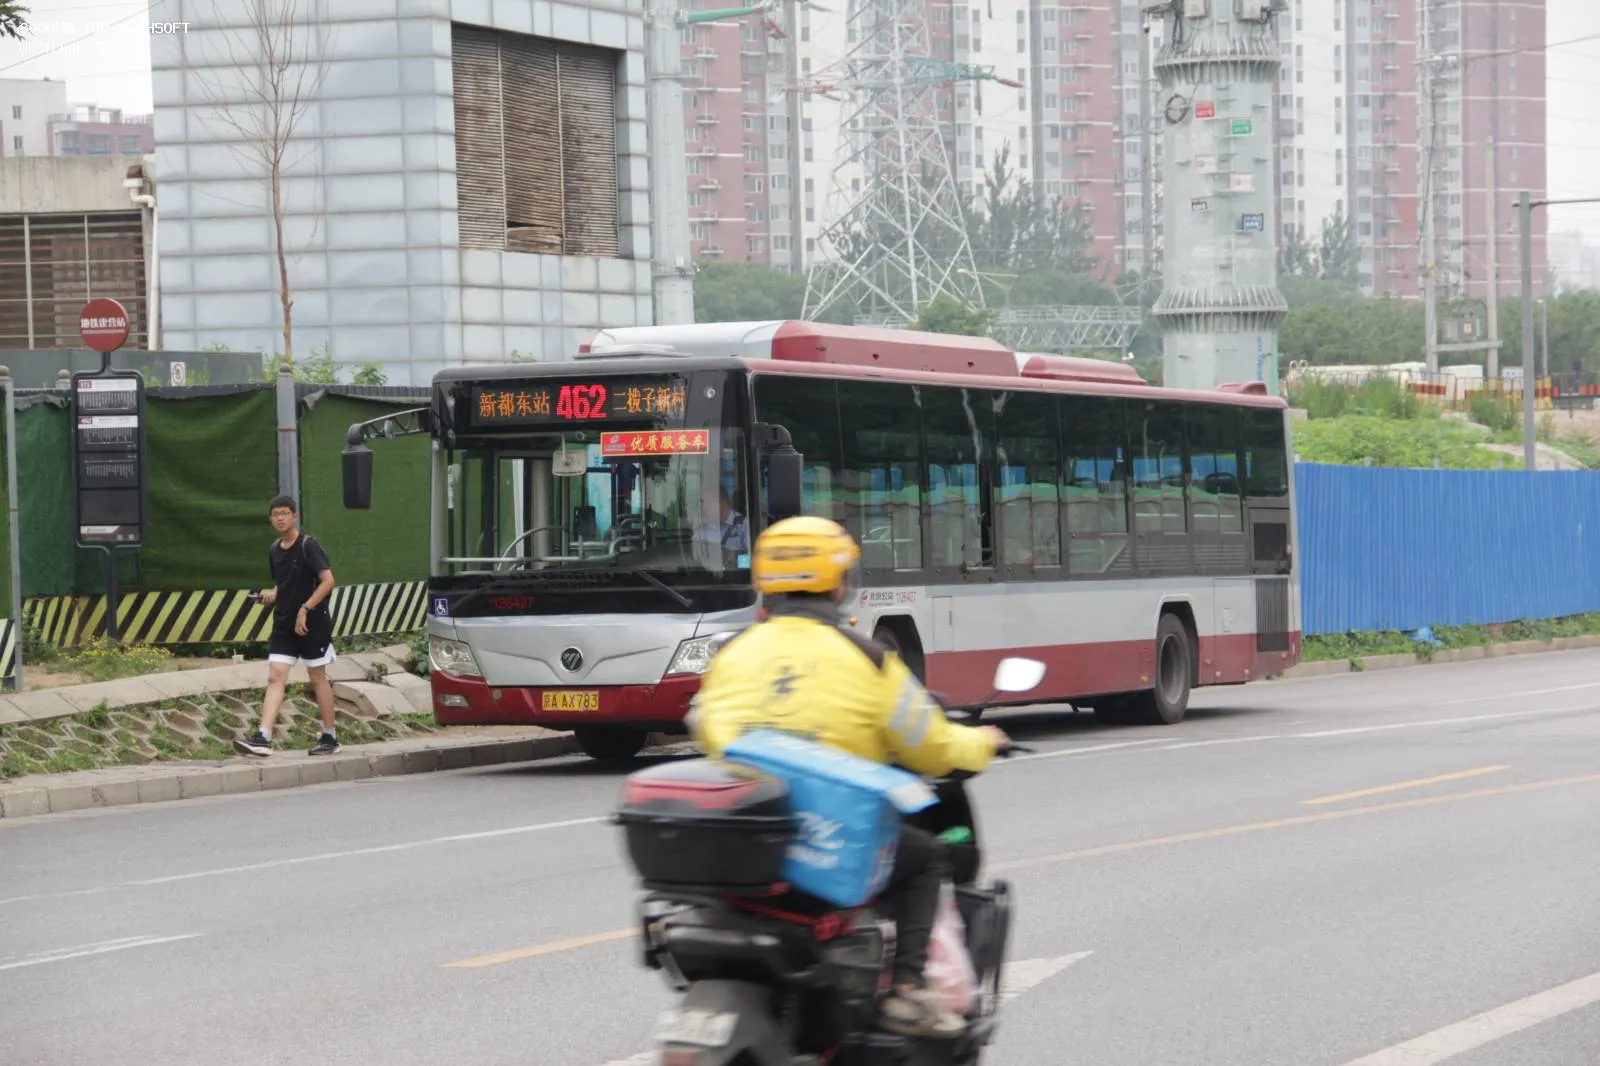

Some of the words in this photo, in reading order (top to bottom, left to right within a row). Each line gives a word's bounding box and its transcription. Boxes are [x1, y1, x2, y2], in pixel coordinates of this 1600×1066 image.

[479, 391, 550, 417] 新都东站
[556, 384, 607, 419] 462
[613, 385, 686, 414] 二拨子新村
[630, 433, 705, 452] 优质服务车
